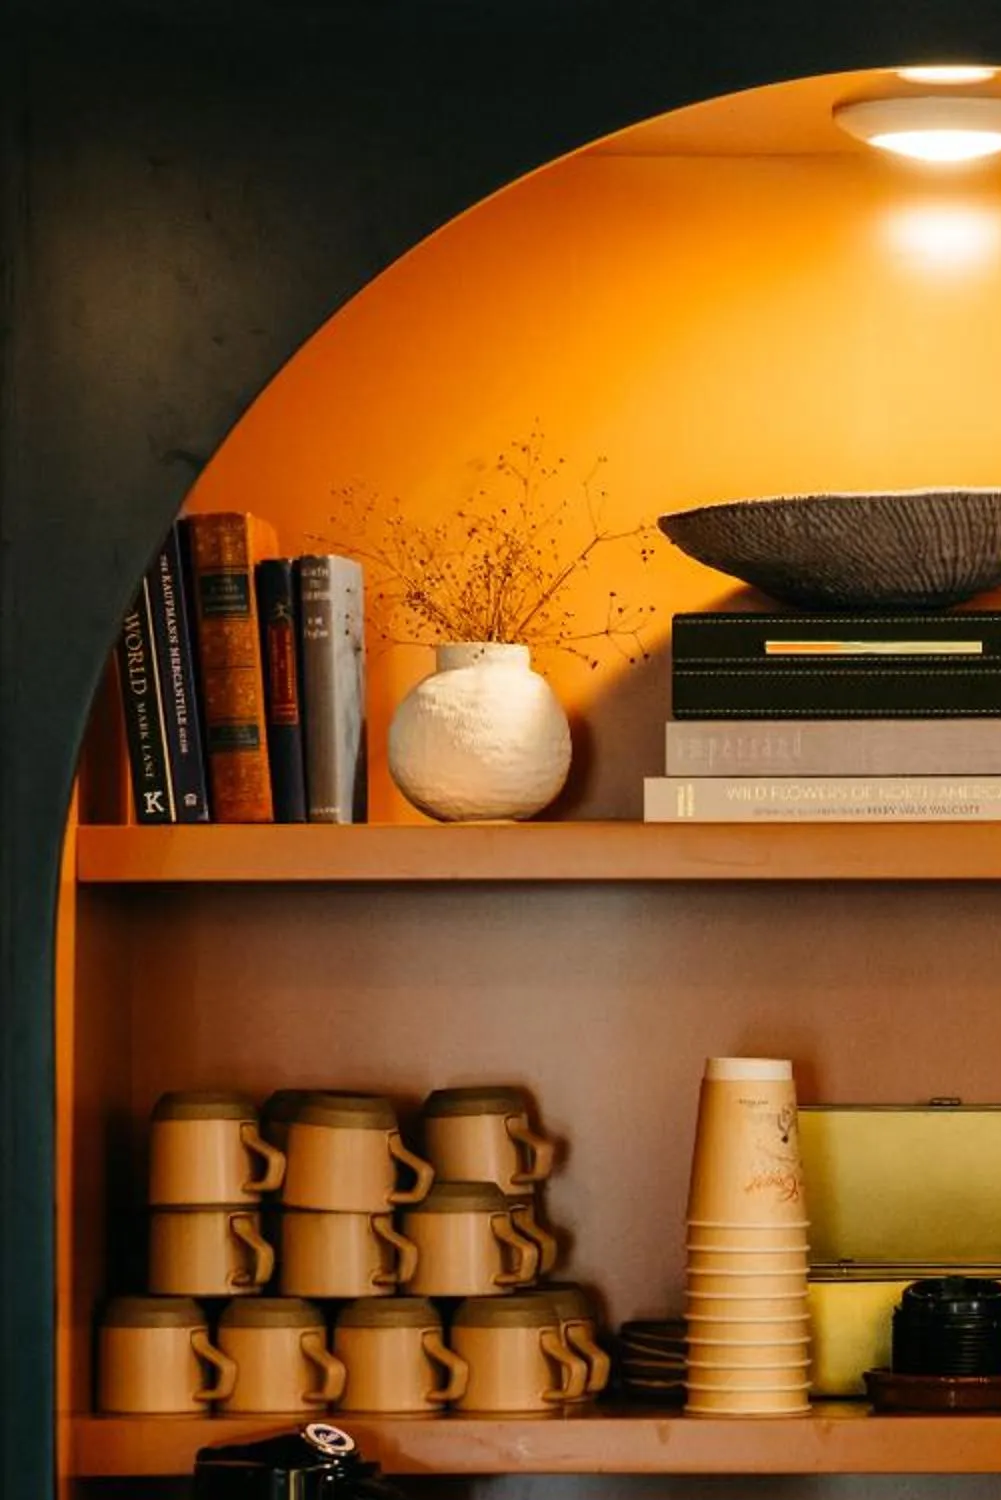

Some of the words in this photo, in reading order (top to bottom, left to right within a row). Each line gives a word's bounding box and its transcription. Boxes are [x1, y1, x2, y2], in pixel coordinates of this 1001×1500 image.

[123, 612, 146, 696] WORLD
[136, 702, 150, 738] MARK
[168, 646, 187, 725] MERCANTILE
[143, 790, 166, 814] K
[727, 784, 767, 801] WILD
[850, 784, 873, 801] OF
